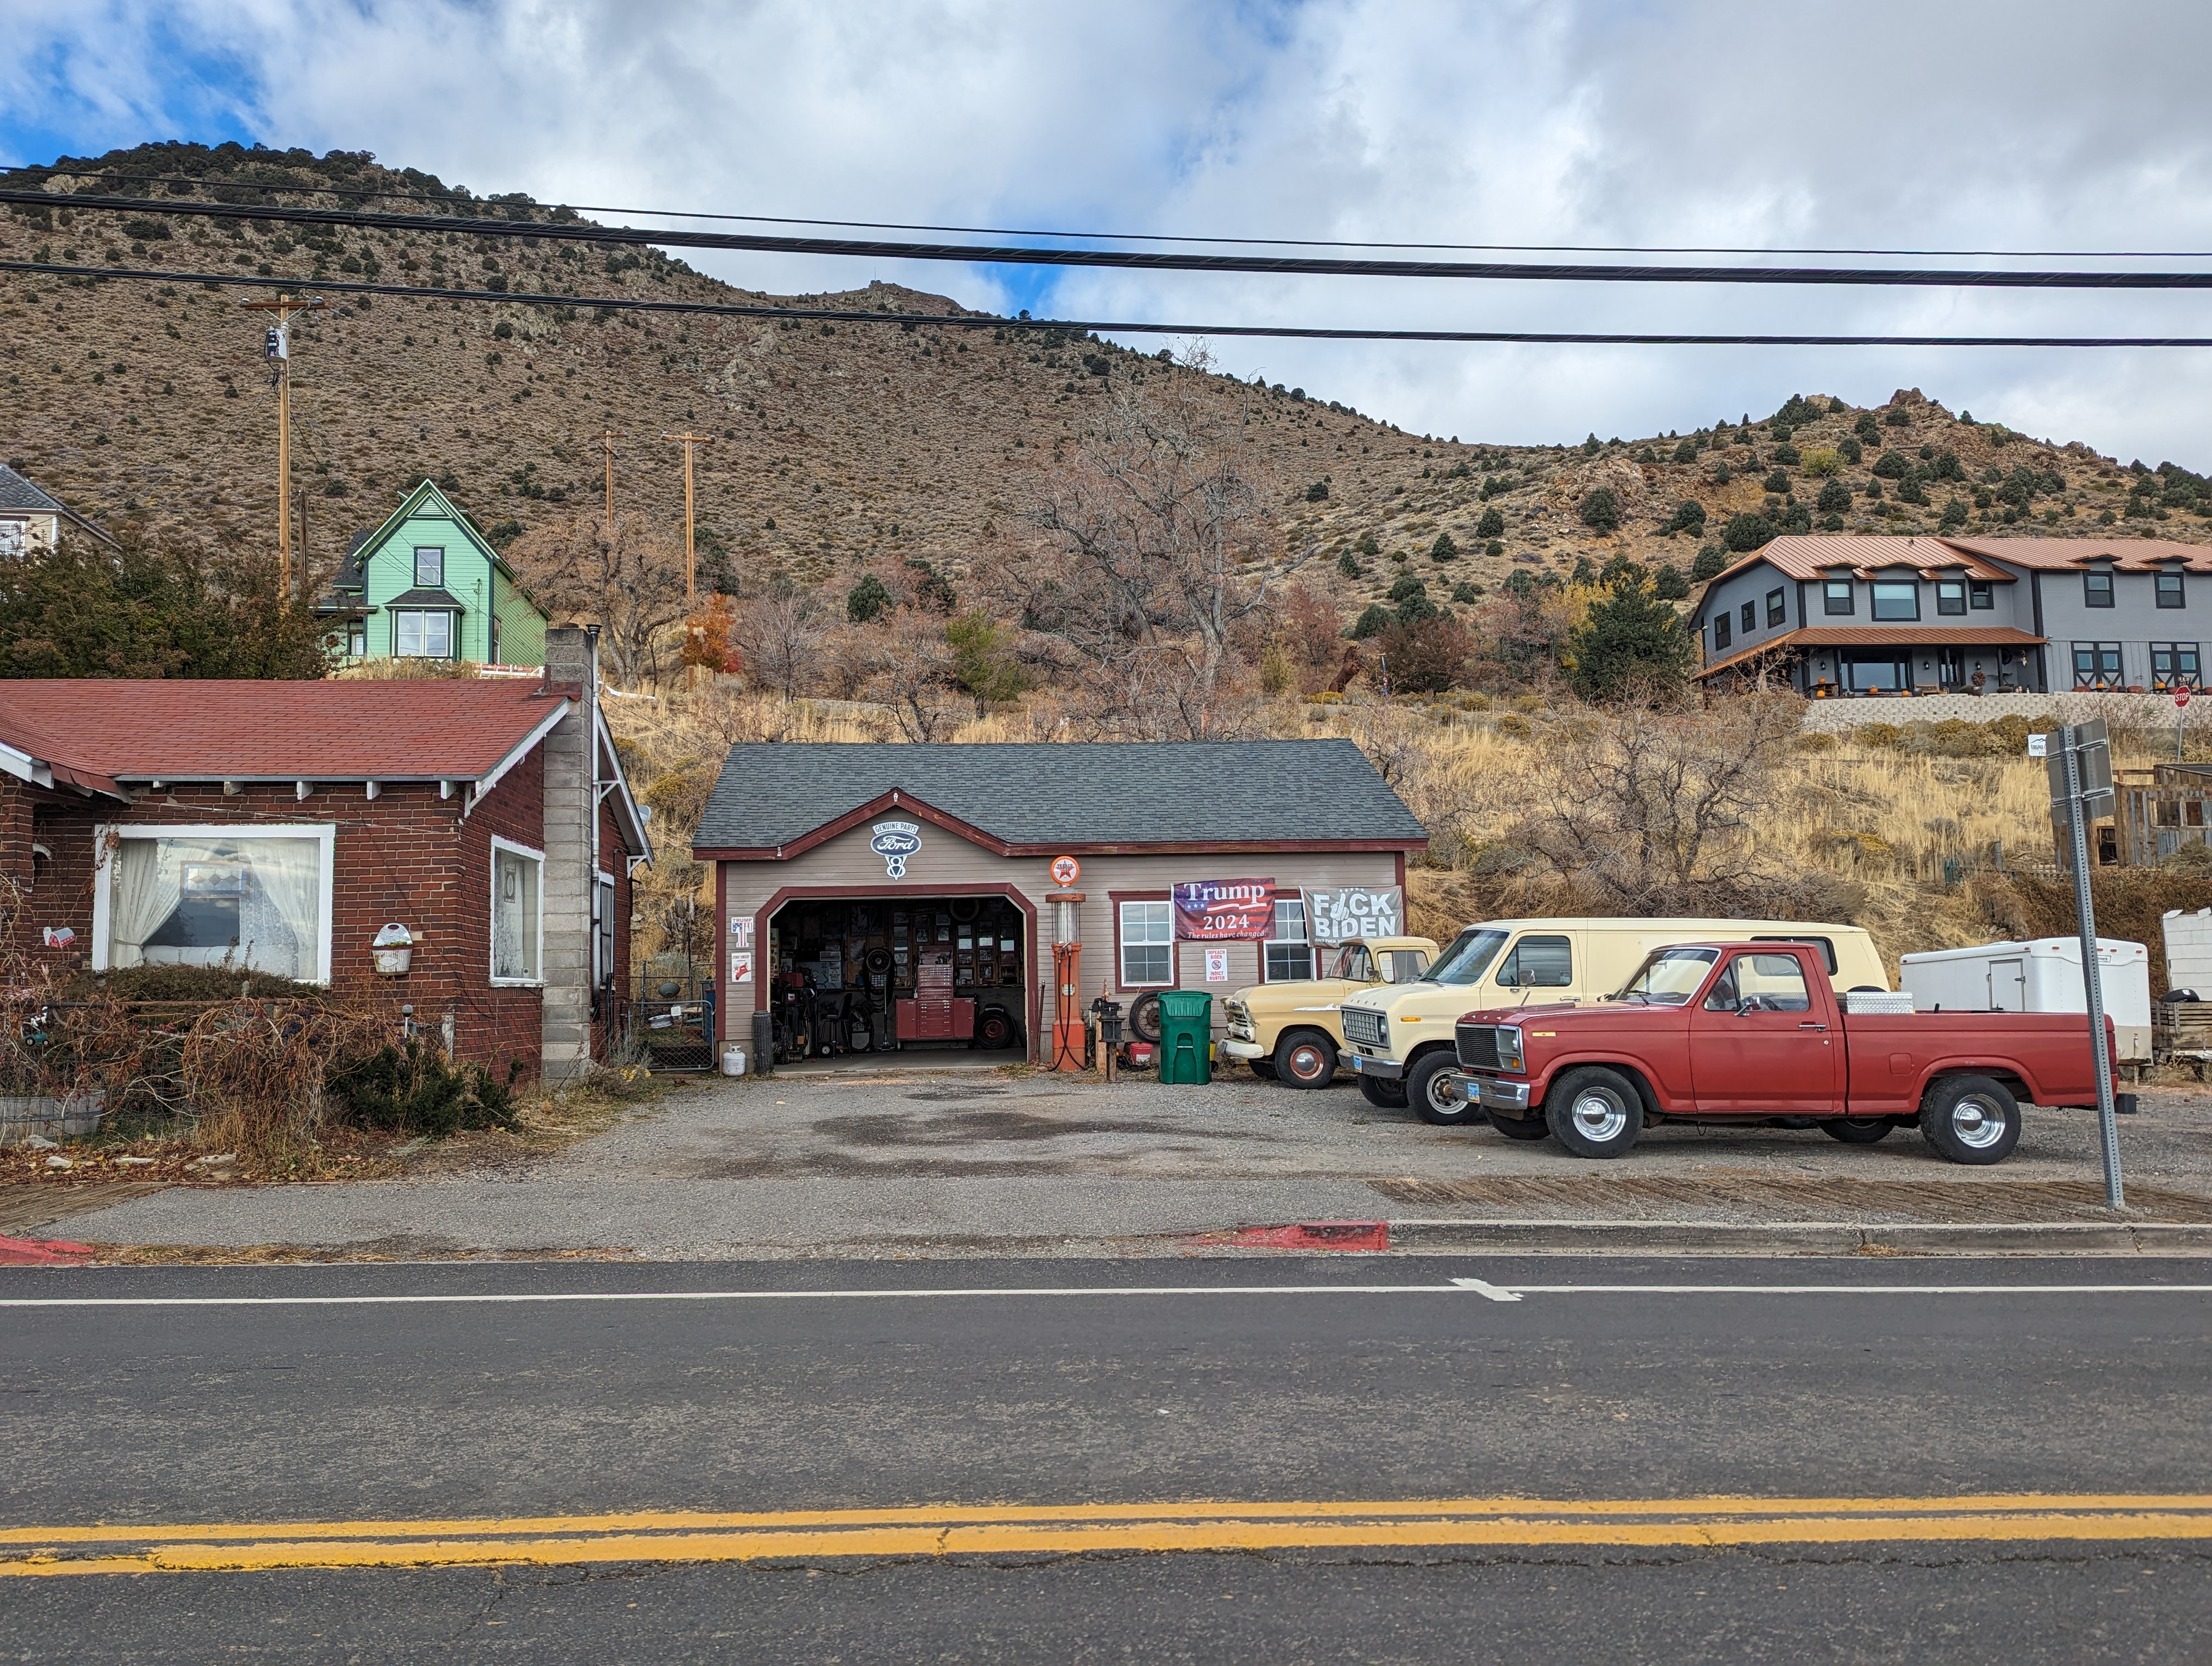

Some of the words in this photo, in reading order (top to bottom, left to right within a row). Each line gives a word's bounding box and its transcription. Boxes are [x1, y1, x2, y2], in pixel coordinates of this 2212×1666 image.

[2176, 693, 2190, 702] STOP
[875, 823, 899, 832] GENUINE
[901, 823, 917, 833] PARTS
[877, 835, 915, 850] Ford
[1184, 883, 1265, 904] Trump
[1203, 914, 1249, 930] 2024
[1314, 916, 1396, 938] BIDEN
[1236, 930, 1266, 939] changed.
